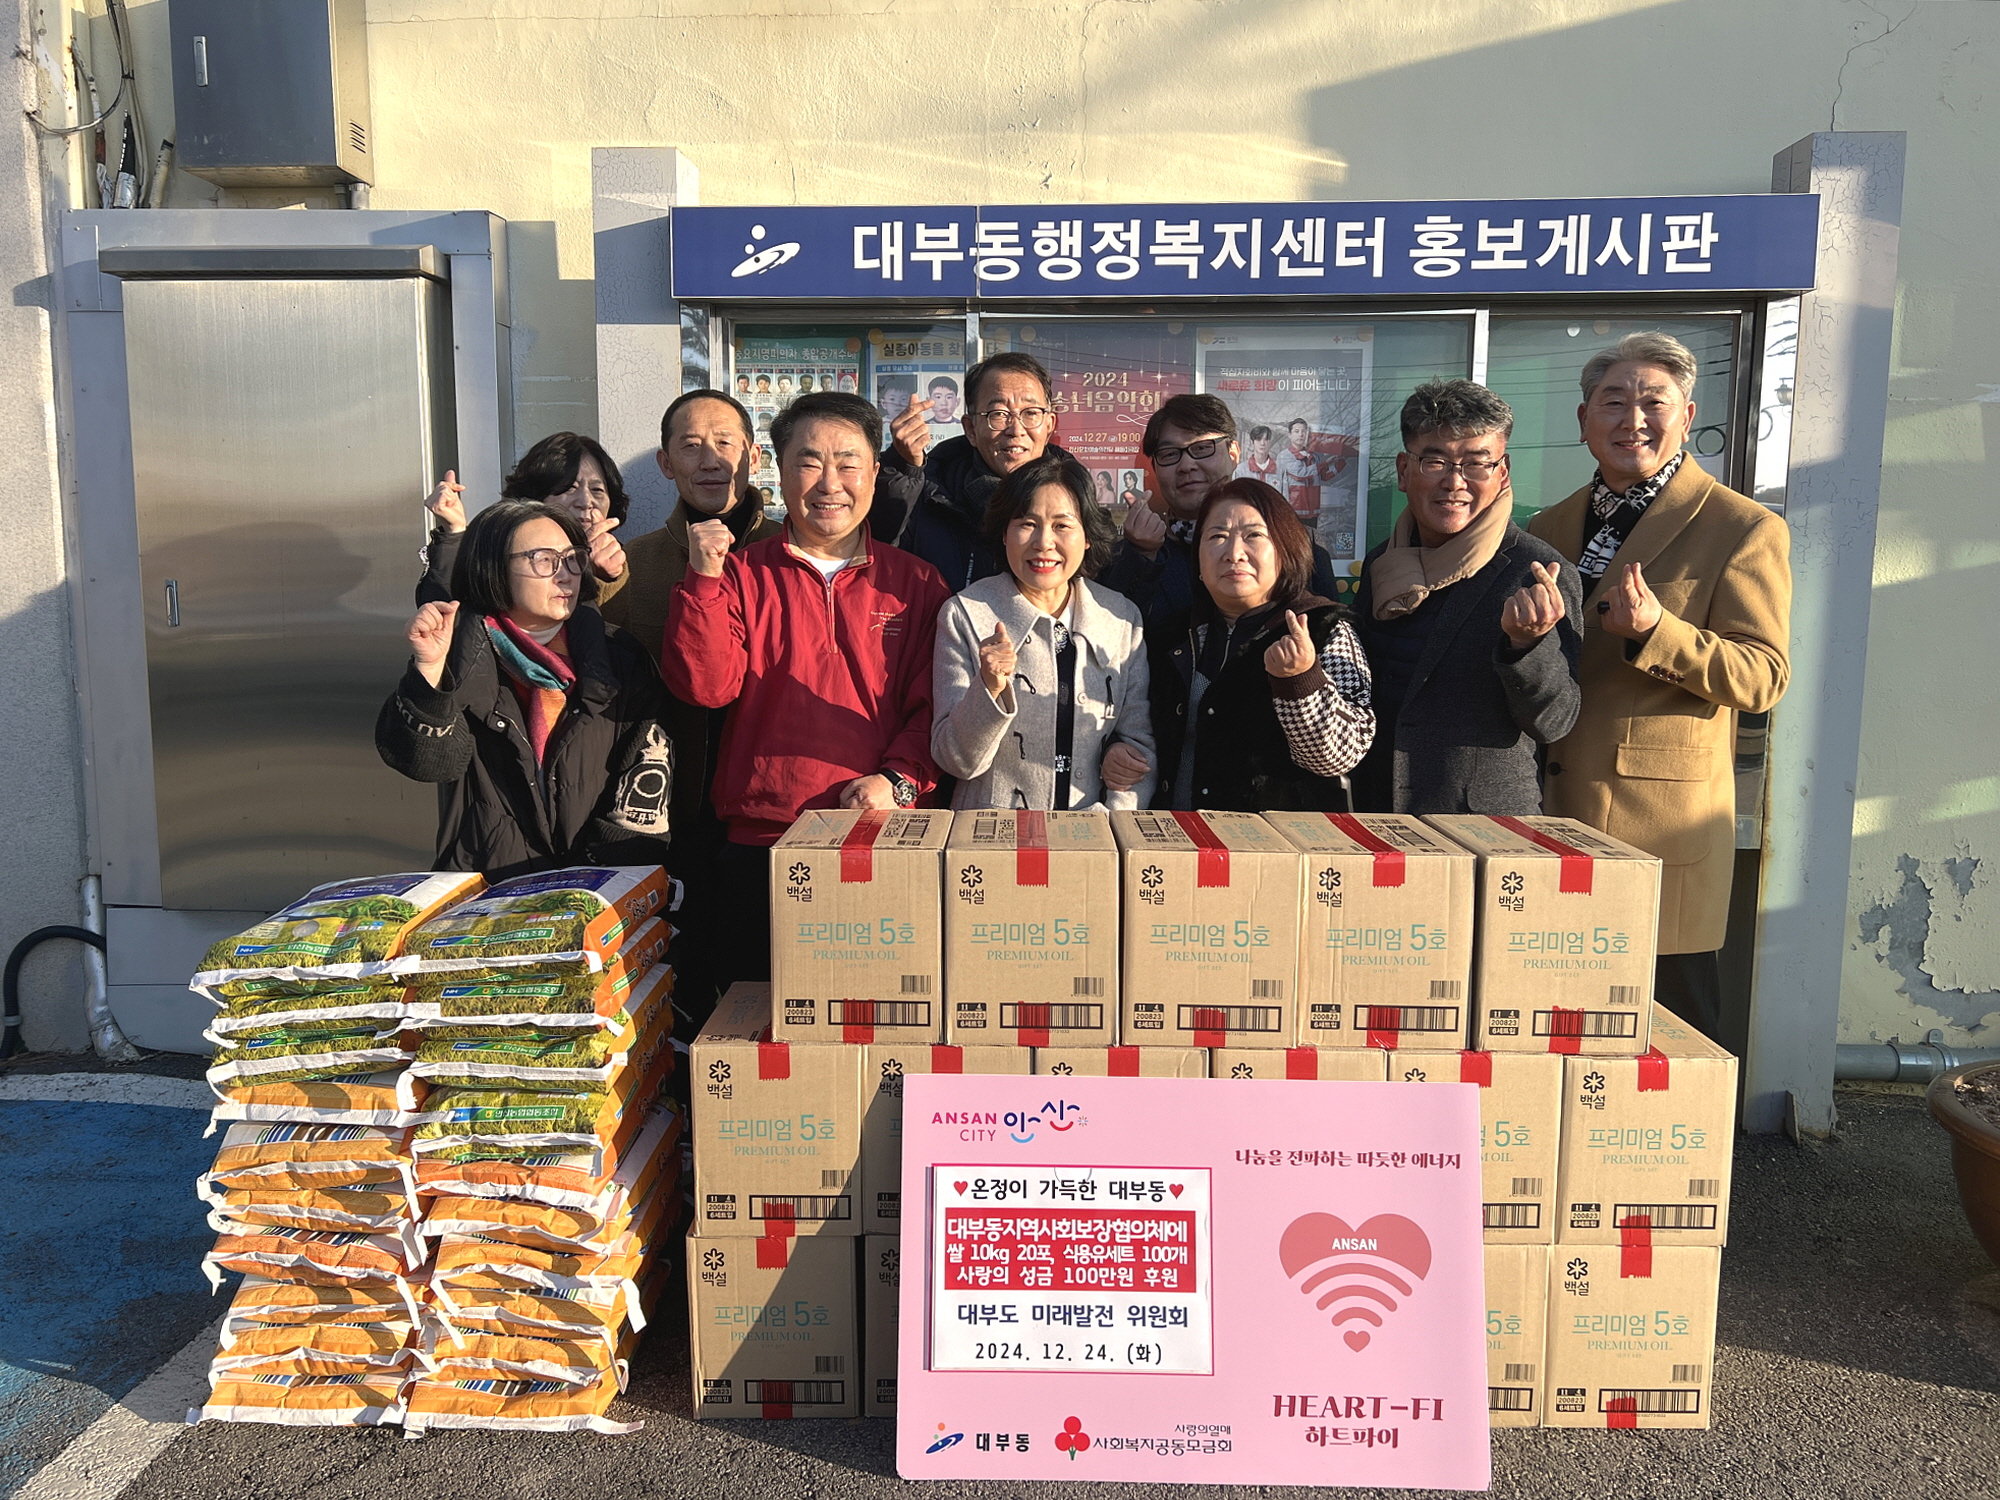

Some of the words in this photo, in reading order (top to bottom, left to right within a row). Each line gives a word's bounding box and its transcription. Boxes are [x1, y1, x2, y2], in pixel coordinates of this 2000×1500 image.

[853, 216, 1386, 281] 대부동행정복지센터
[1409, 212, 1719, 278] 홍보게시판
[883, 342, 944, 357] 실종아동을
[1082, 371, 1129, 387] 2024
[1290, 366, 1316, 376] 마음이
[1217, 379, 1251, 392] 새로운
[1292, 378, 1351, 392] 피어납니다
[1051, 390, 1162, 413] 송년음악회
[786, 885, 813, 902] 백설
[958, 888, 985, 905] 백설
[1138, 889, 1165, 906] 백설
[1316, 891, 1343, 908] 백설
[1498, 895, 1525, 912] 백설
[797, 922, 872, 945] 프리미엄
[879, 917, 916, 946] 5호
[970, 922, 1046, 946] 프리미엄
[1053, 918, 1090, 946] 5호
[1150, 924, 1226, 947] 프리미엄
[1233, 920, 1270, 948] 5호
[1325, 927, 1401, 951] 프리미엄
[1409, 924, 1447, 951] 5호
[1507, 931, 1585, 954] 프리미엄
[1592, 927, 1630, 954] 5호
[813, 949, 875, 961] PREMIUM
[877, 949, 900, 961] OIL
[987, 950, 1049, 961] PREMIUM
[1051, 950, 1074, 961] OIL
[1165, 951, 1228, 963] PREMIUM
[1230, 952, 1253, 963] OIL
[1342, 954, 1405, 966] PREMIUM
[1406, 954, 1431, 966] OIL
[1523, 958, 1586, 970] PREMIUM
[1587, 958, 1612, 971] OIL
[707, 1083, 733, 1100] 백설
[1579, 1094, 1606, 1110] 백설
[931, 1112, 997, 1125] ANSAN
[717, 1118, 792, 1141] 프리미엄
[800, 1114, 836, 1141] 5호
[959, 1129, 997, 1142] CITY
[1587, 1128, 1663, 1150] 프리미엄
[1669, 1124, 1707, 1150] 5호
[734, 1145, 795, 1156] PREMIUM
[797, 1145, 820, 1156] OIL
[1490, 1152, 1514, 1162] OIL
[1234, 1149, 1283, 1166] 나눔을
[1287, 1150, 1352, 1167] 전파하는
[1411, 1152, 1461, 1170] 에너지
[1602, 1154, 1665, 1165] PREMIUM
[1666, 1154, 1690, 1165] OIL
[971, 1178, 1028, 1200] 온정이
[1039, 1179, 1097, 1201] 가득한
[1109, 1180, 1166, 1202] 대부동
[947, 1217, 1187, 1243] 대부동지역사회보장협의체에
[1332, 1238, 1378, 1251] ANSAN
[947, 1243, 965, 1263] 쌀
[970, 1243, 1010, 1264] 10kg
[1017, 1244, 1054, 1265] 20포,
[1063, 1244, 1135, 1265] 식용유세트
[1142, 1245, 1187, 1265] 100개
[701, 1271, 727, 1288] 백설
[957, 1265, 1009, 1285] 사랑의
[1019, 1266, 1052, 1286] 성금
[1064, 1266, 1134, 1287] 100만원
[1143, 1267, 1179, 1288] 후원
[1564, 1280, 1590, 1296] 백설
[714, 1305, 786, 1327] 프리미엄
[794, 1301, 830, 1327] 5호
[957, 1304, 1019, 1326] 대부도
[1032, 1304, 1114, 1328] 미래발전
[1126, 1305, 1188, 1328] 위원회
[1571, 1314, 1646, 1337] 프리미엄
[1653, 1310, 1690, 1337] 5호
[730, 1331, 791, 1342] PREMIUM
[792, 1331, 815, 1342] OIL
[975, 1343, 1030, 1361] 2024.
[1043, 1343, 1073, 1362] 12.
[1085, 1344, 1115, 1362] 24.
[1127, 1343, 1162, 1365] (화)
[1587, 1340, 1649, 1351] PREMIUM
[1650, 1340, 1673, 1351] OIL
[1272, 1394, 1444, 1421] HEART-FI
[1174, 1424, 1232, 1437] 사랑의열매
[1304, 1425, 1399, 1449] 하트파이
[976, 1432, 1030, 1453] 대부동
[1093, 1436, 1232, 1457] 사회복지공동모금회
